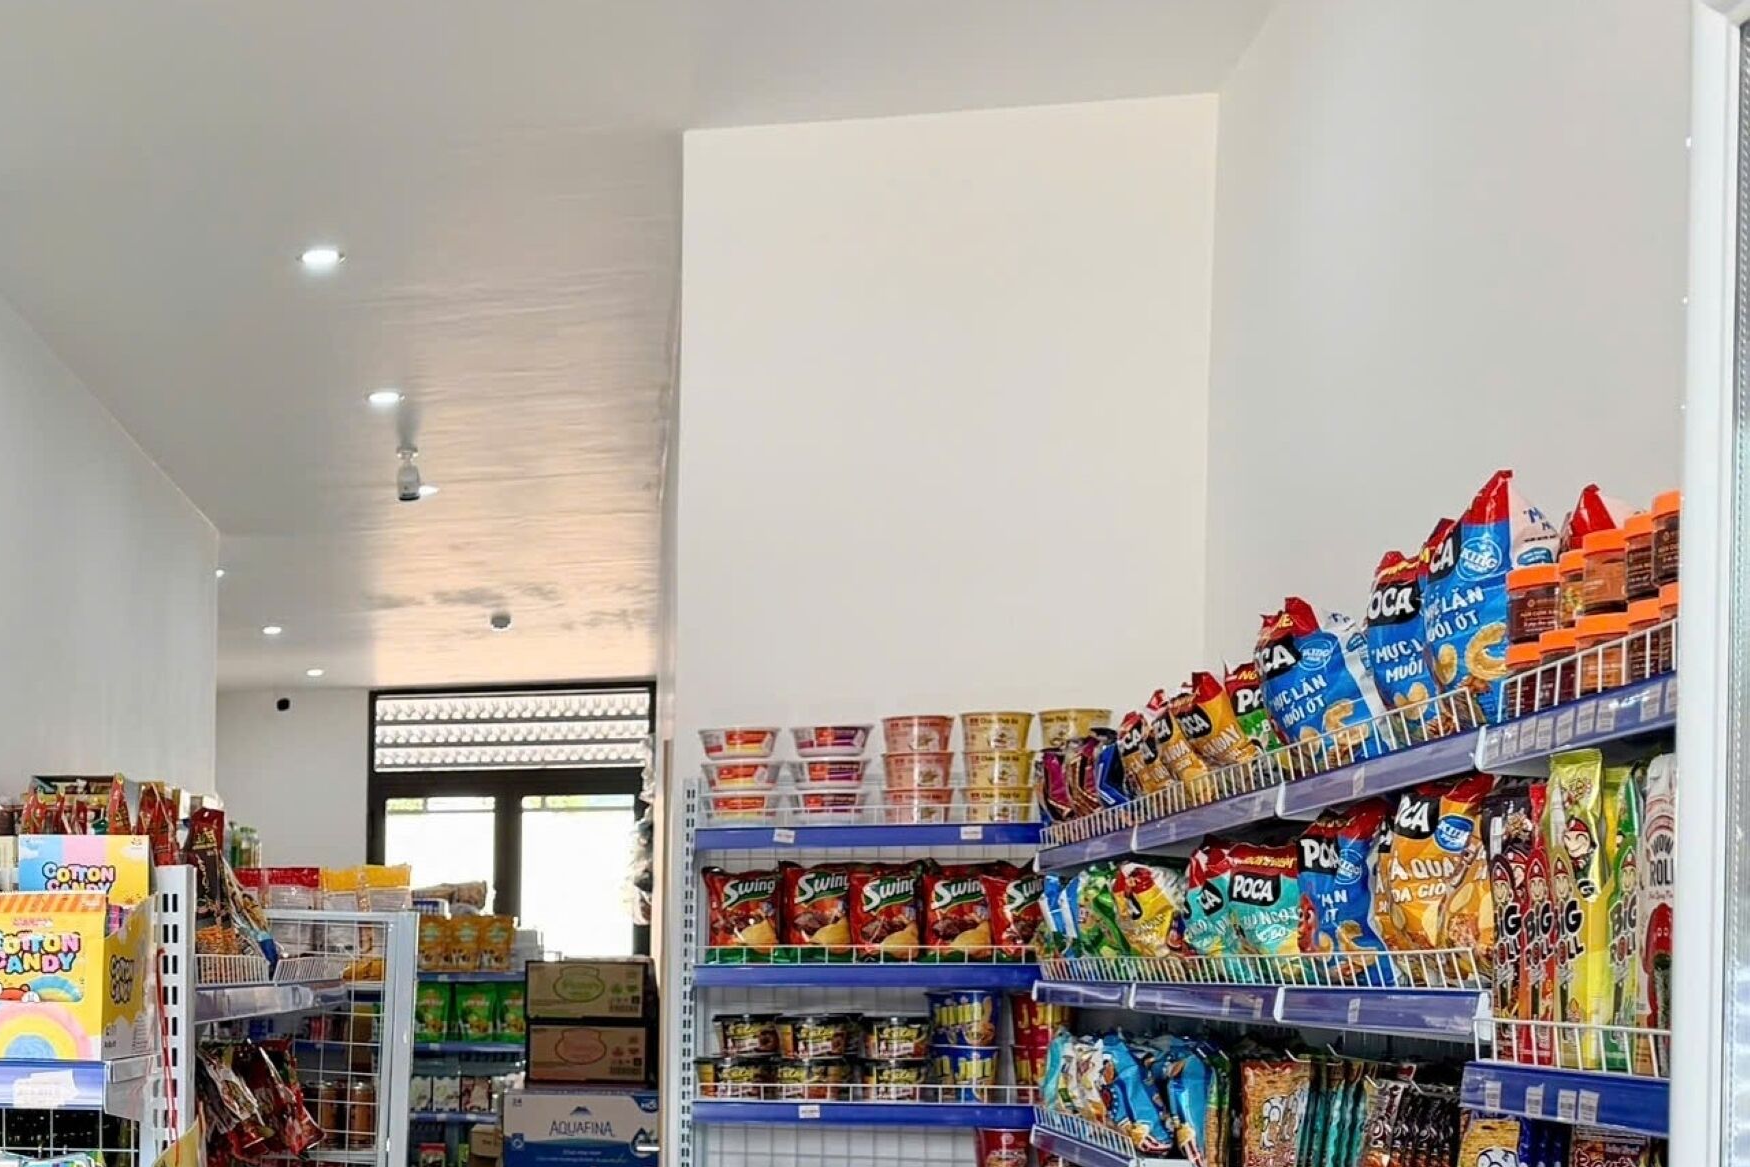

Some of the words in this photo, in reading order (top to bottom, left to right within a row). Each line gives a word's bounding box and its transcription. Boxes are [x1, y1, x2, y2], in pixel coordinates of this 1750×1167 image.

[1369, 587, 1413, 622] OCA
[42, 862, 116, 883] COTTON
[1233, 872, 1275, 902] POCA
[723, 878, 777, 908] Swing
[932, 875, 985, 909] Swin
[549, 1120, 616, 1138] AQUAFINA
